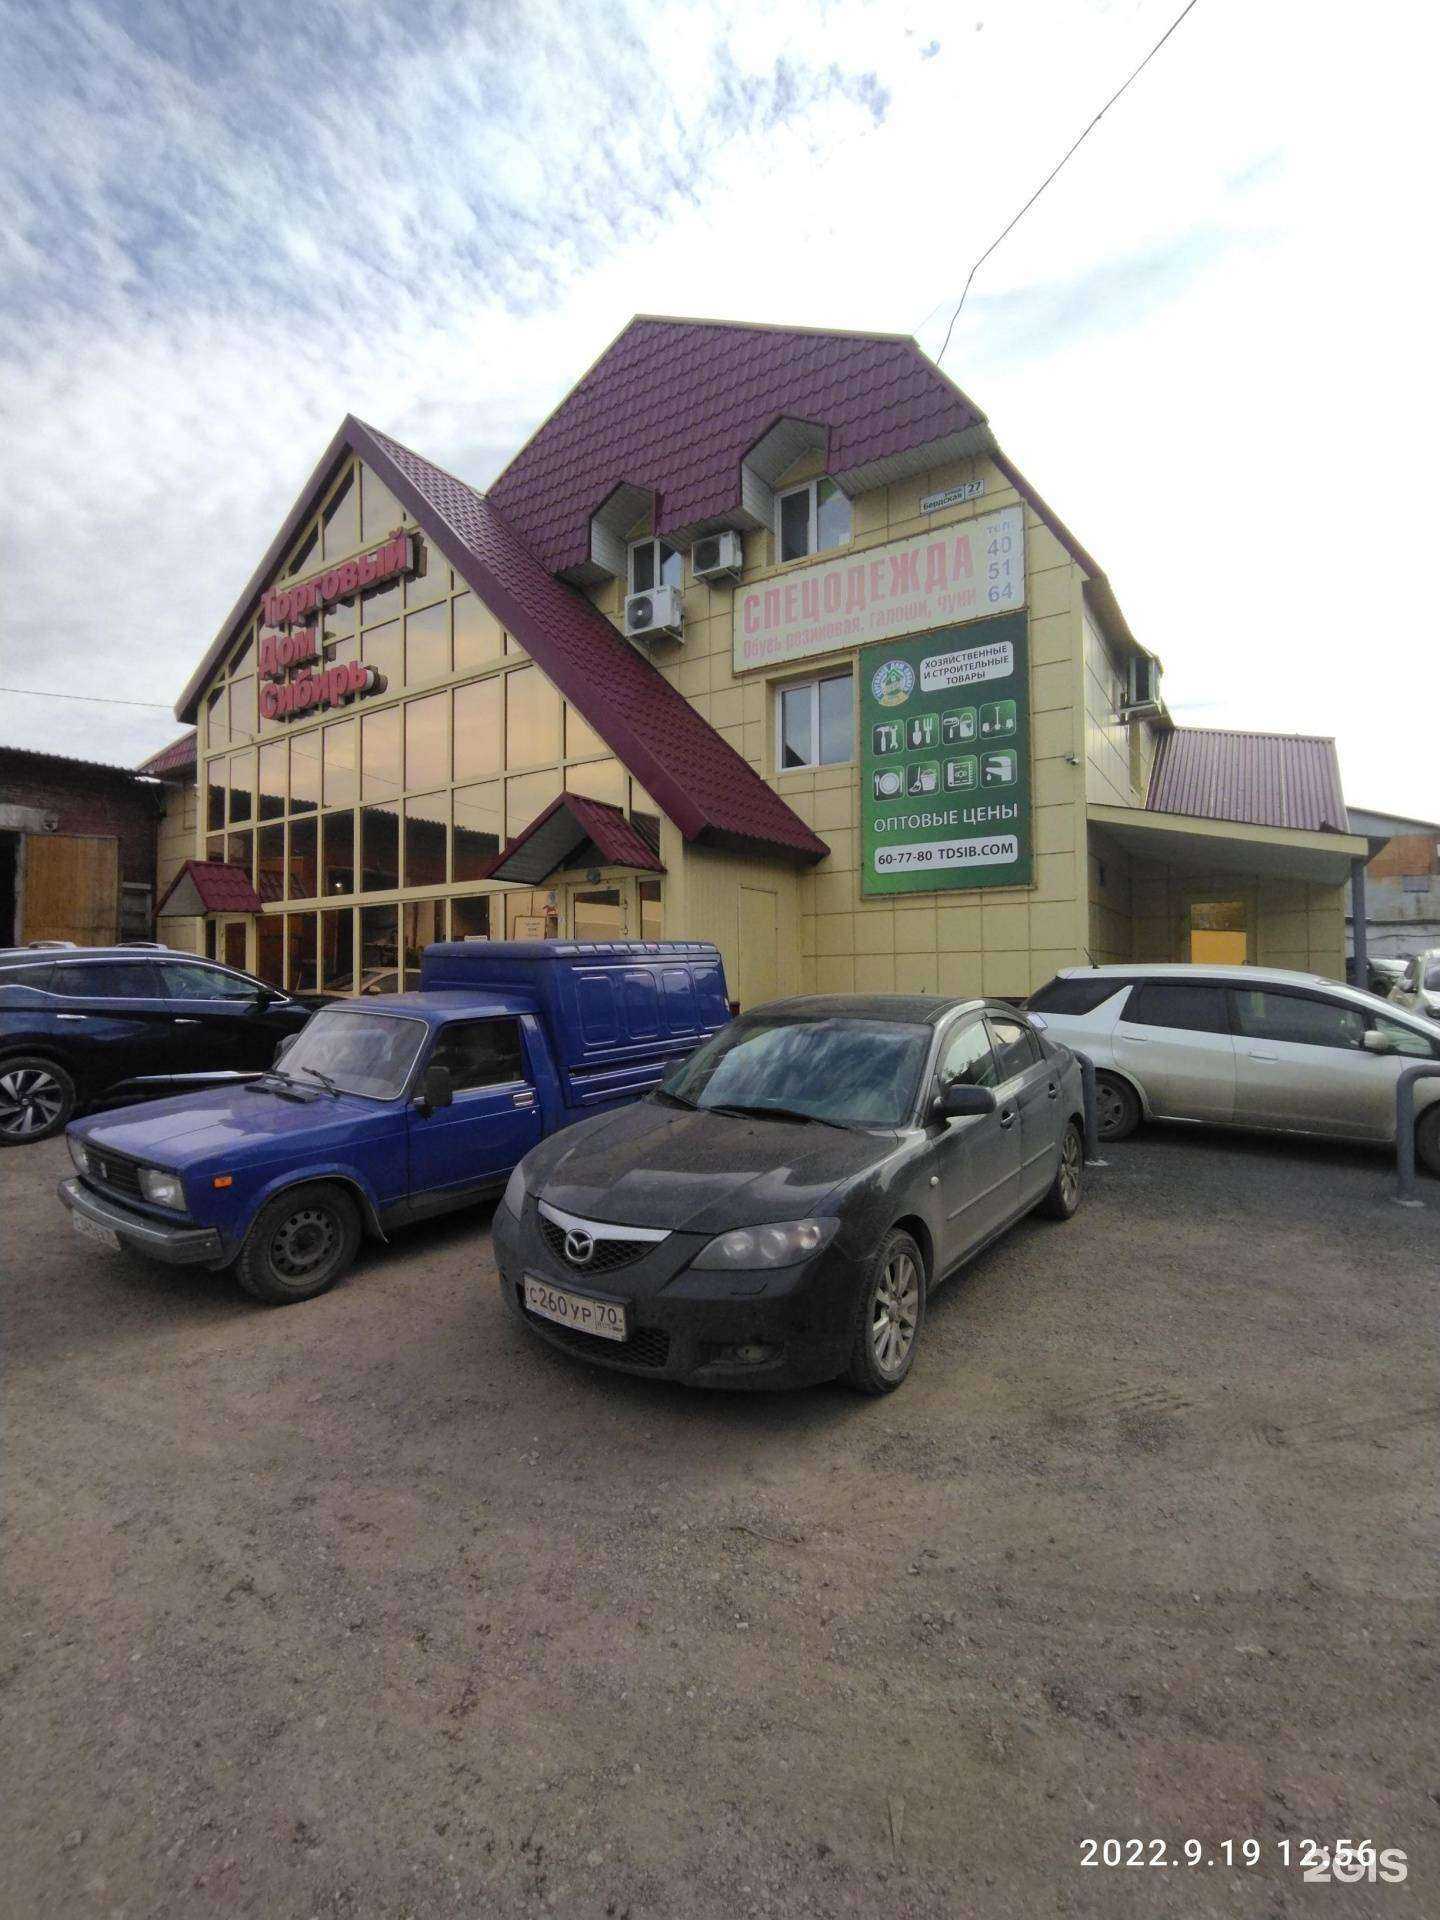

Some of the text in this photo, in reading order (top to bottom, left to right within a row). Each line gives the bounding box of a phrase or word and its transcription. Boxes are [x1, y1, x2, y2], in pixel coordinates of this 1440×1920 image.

[967, 481, 982, 493] 27
[987, 535, 1012, 556] 40
[988, 558, 1010, 580] 51
[743, 534, 974, 634] СПЕЦОДЕЖДА
[988, 581, 1013, 602] 64
[924, 644, 1008, 668] ХОЗЯЙСТВЕННЫЕ
[924, 669, 932, 680] И
[932, 655, 1009, 678] СТРОИТЕЛЬНЫЕ
[946, 672, 986, 685] ТОВАРЫ
[874, 803, 1018, 832] ОПТОВЫЕ ЦЕНЫ
[878, 842, 1013, 865] 60-77-80 TDSIB.COM
